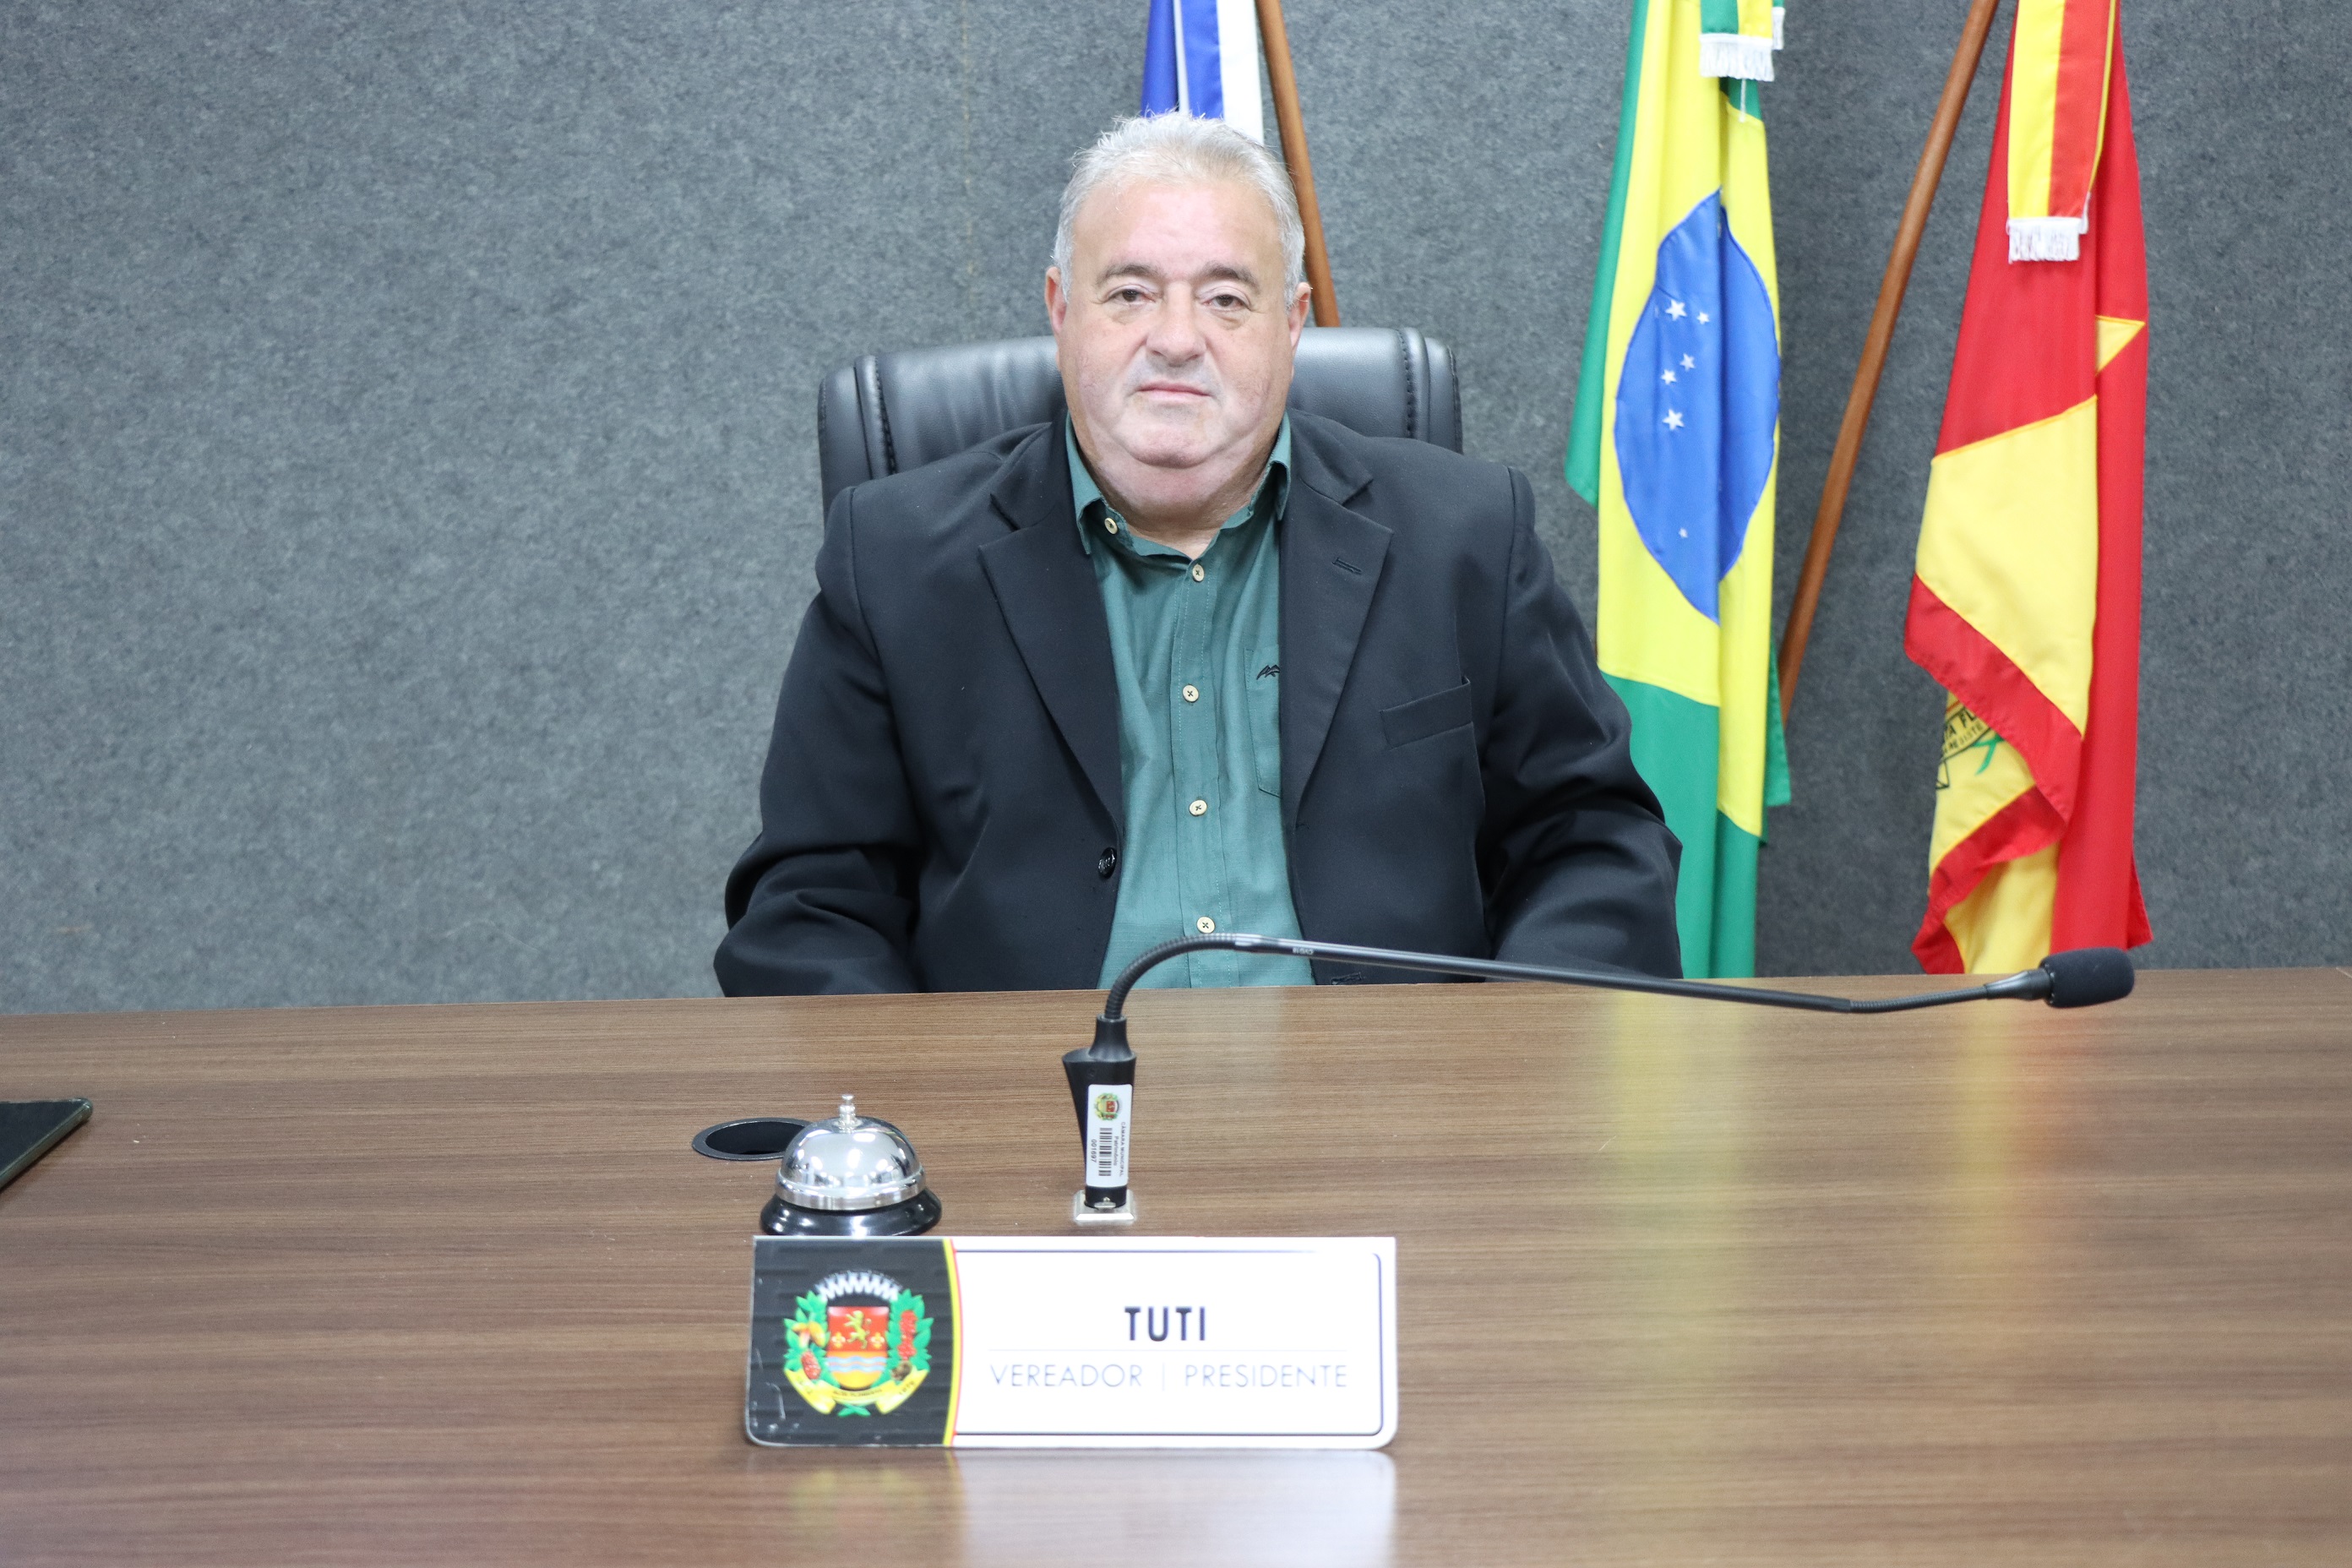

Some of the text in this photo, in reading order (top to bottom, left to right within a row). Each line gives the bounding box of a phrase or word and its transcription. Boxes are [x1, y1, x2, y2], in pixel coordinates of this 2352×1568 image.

[1124, 1306, 1206, 1342] TUTI
[990, 1364, 1348, 1387] VEREADOR PRESIDENTE
